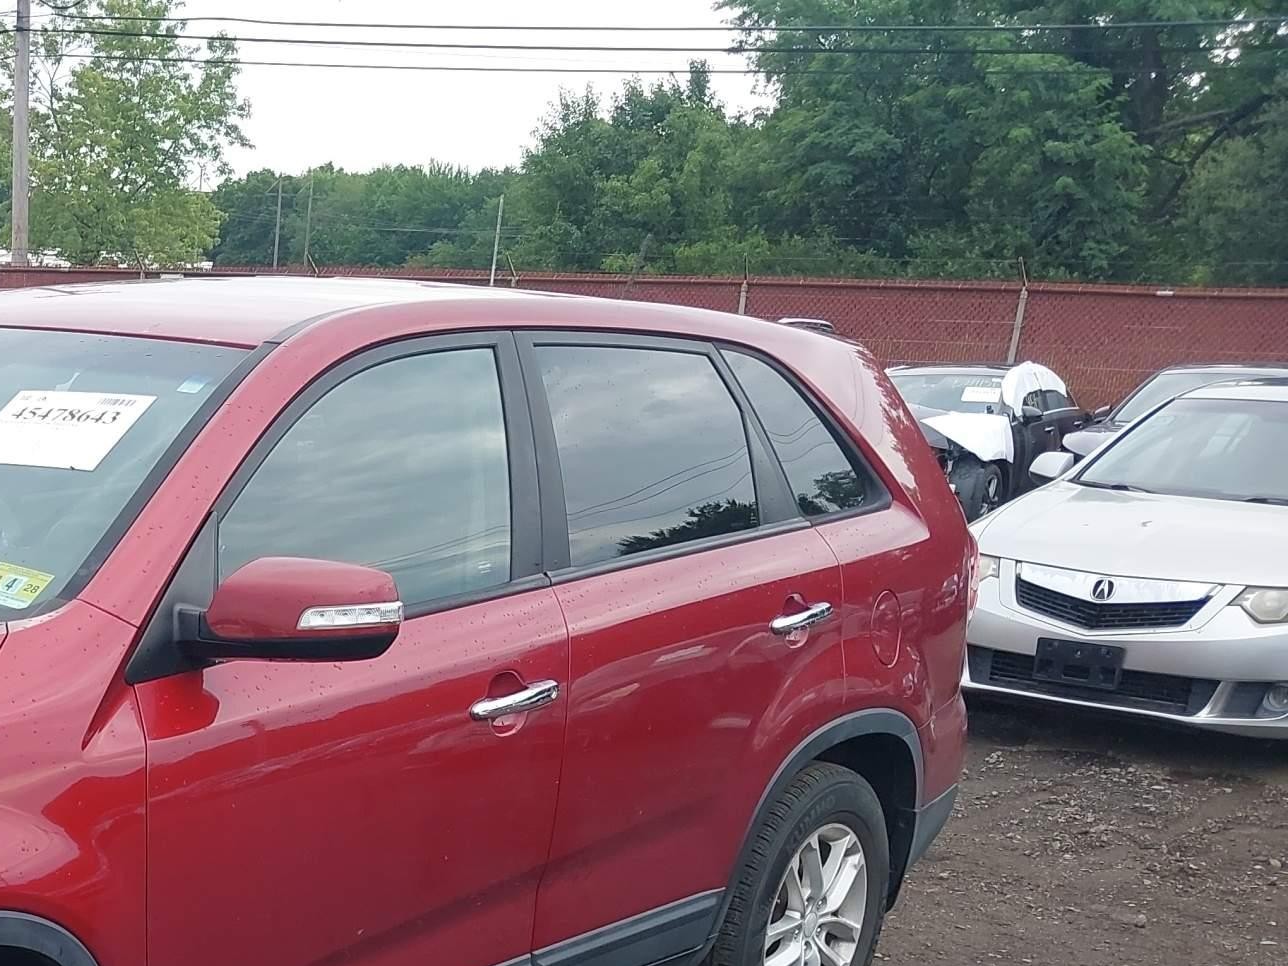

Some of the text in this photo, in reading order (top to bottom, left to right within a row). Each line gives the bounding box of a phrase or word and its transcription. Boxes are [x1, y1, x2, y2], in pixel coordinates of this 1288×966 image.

[11, 406, 121, 425] 45478643
[5, 577, 18, 592] 4
[23, 583, 40, 594] 28
